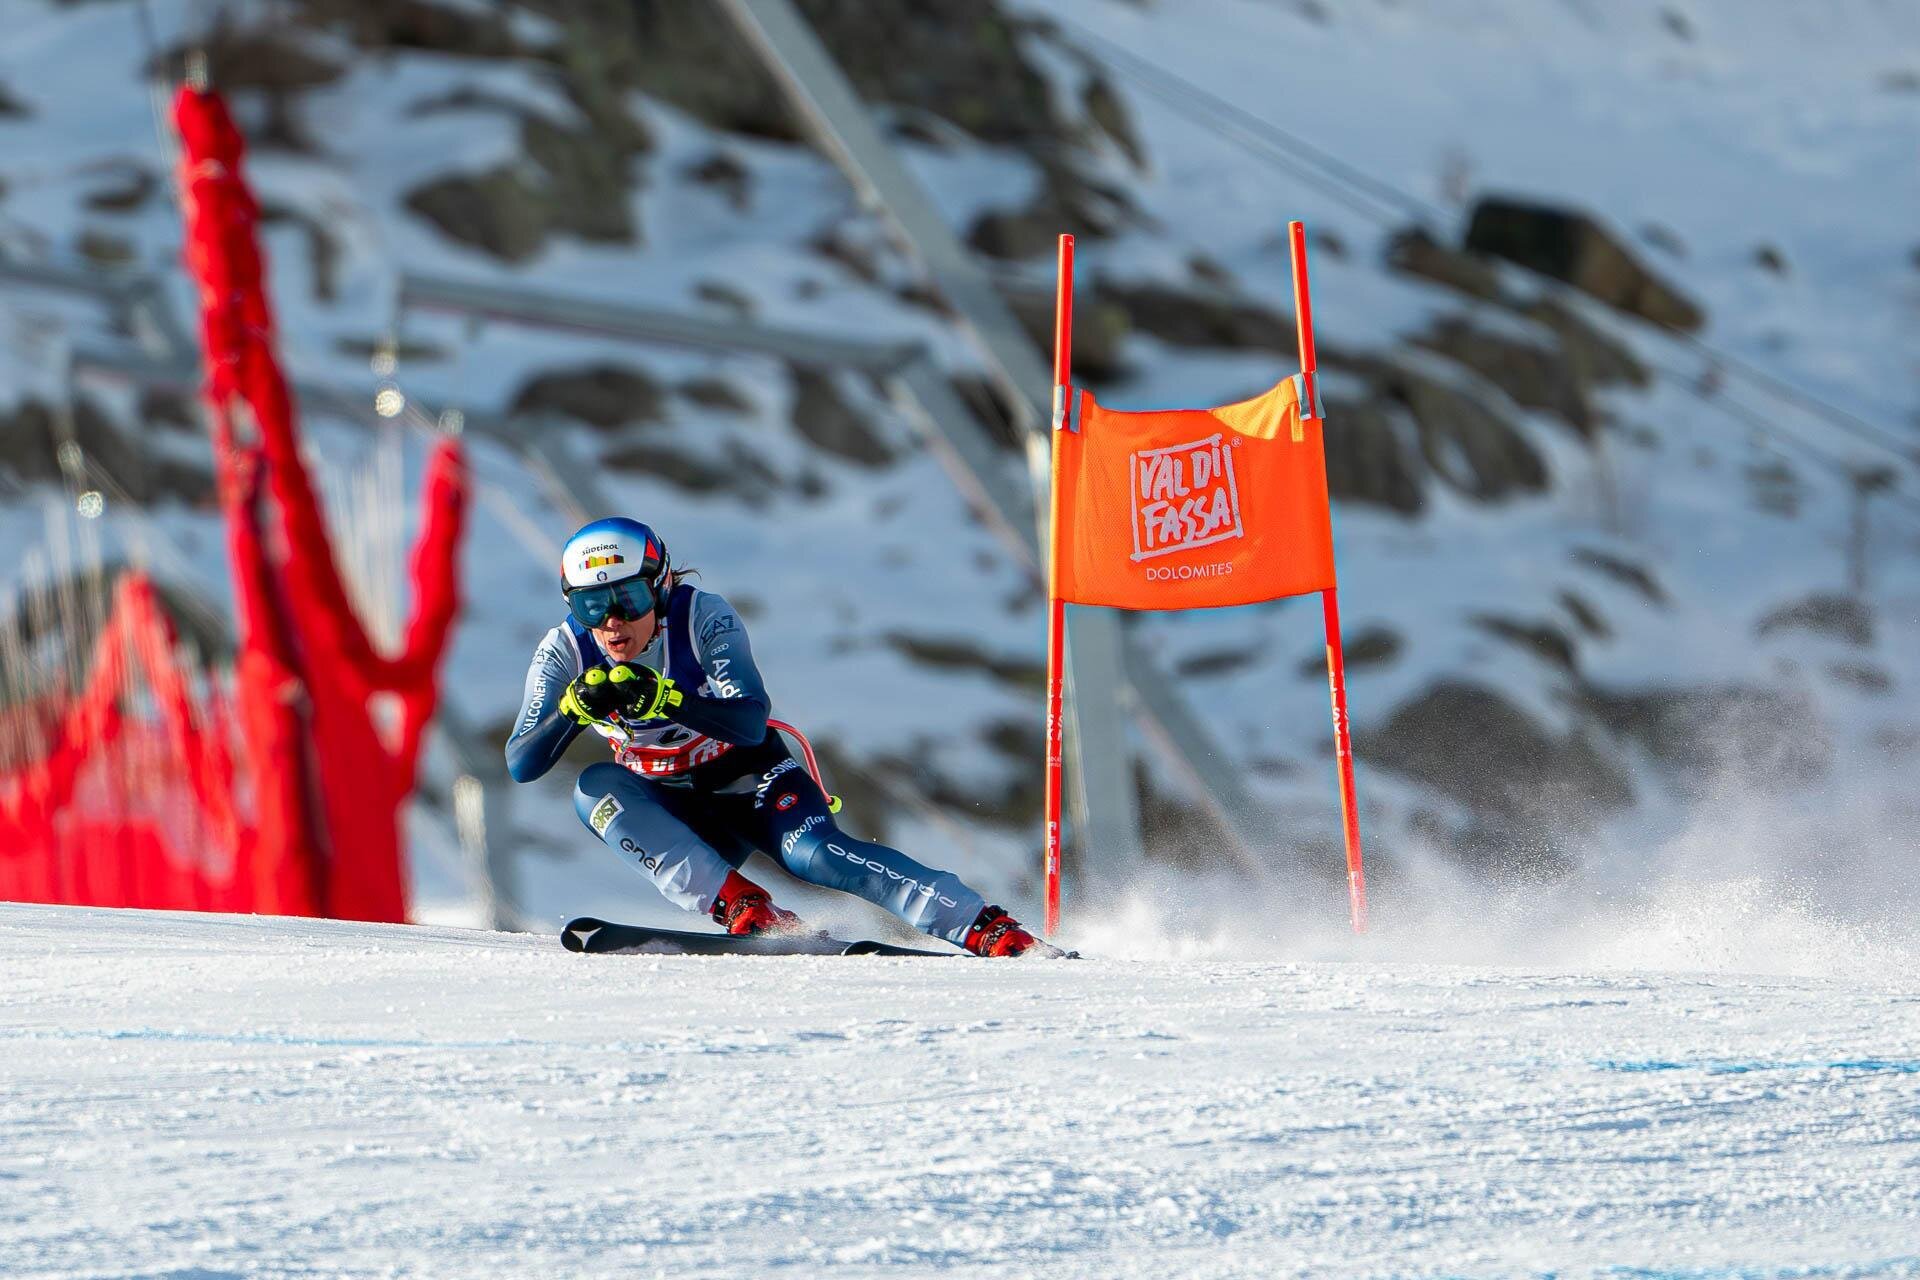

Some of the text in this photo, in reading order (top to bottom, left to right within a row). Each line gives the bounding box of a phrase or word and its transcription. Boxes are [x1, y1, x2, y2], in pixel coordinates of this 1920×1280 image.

[1140, 453, 1190, 500] VAL
[1141, 487, 1231, 547] FASSA
[1146, 562, 1233, 581] DOLOMITES
[784, 815, 826, 855] Dicoflor
[620, 838, 664, 876] enel
[827, 843, 957, 908] PIQUADRO
